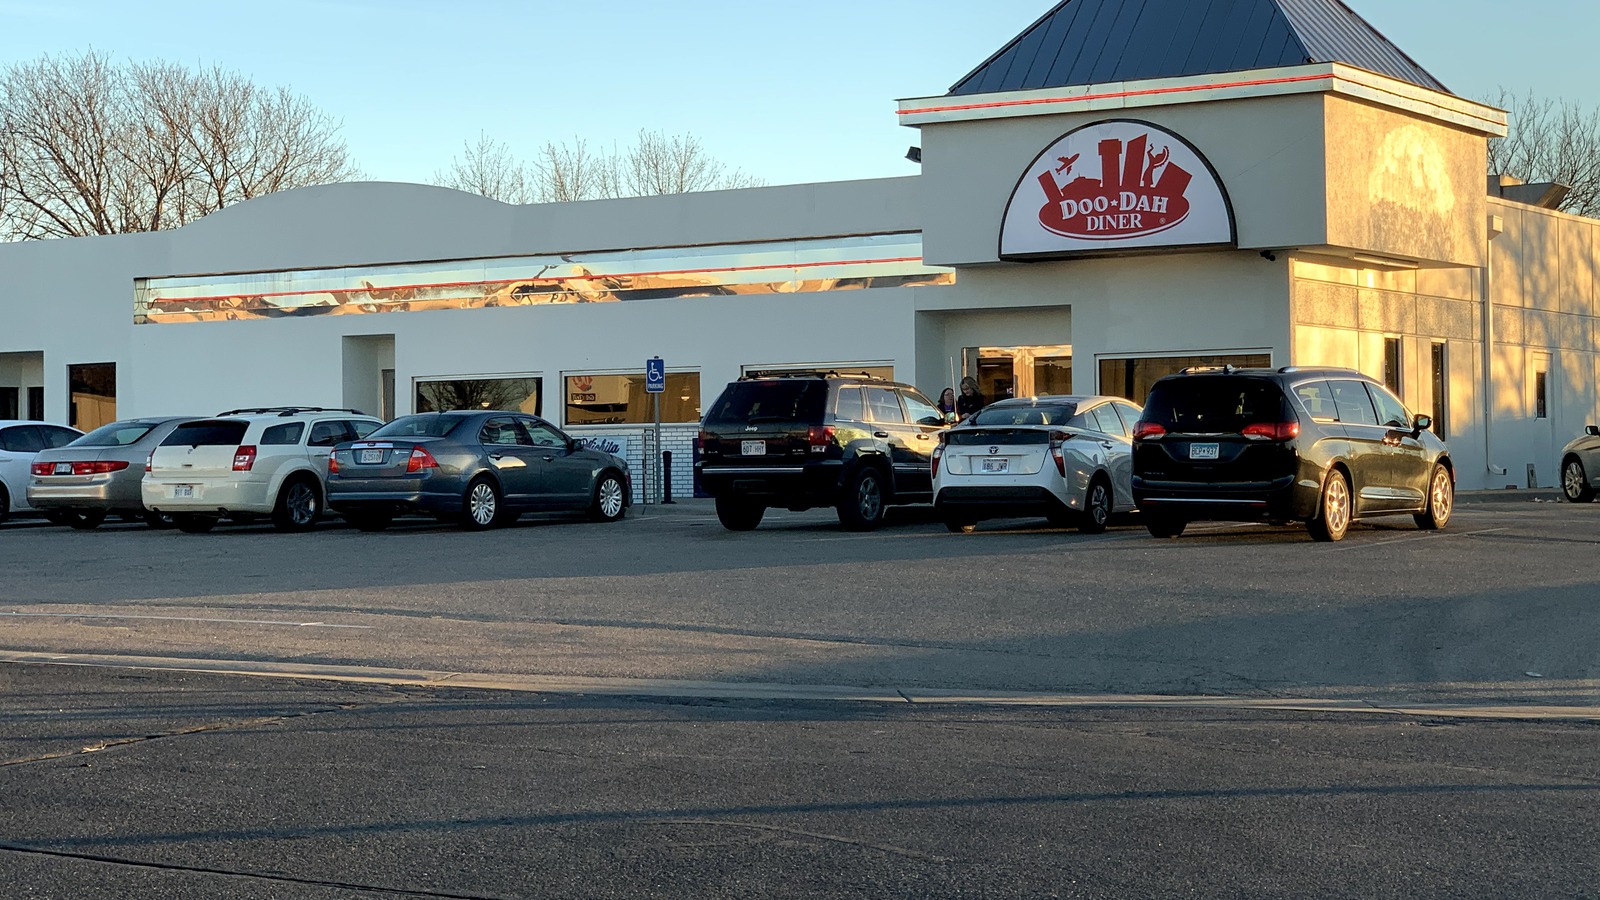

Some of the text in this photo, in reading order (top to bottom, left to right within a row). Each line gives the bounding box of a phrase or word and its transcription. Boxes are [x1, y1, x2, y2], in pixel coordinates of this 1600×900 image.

[1059, 191, 1169, 220] DOO DAH
[1086, 213, 1143, 231] DINER
